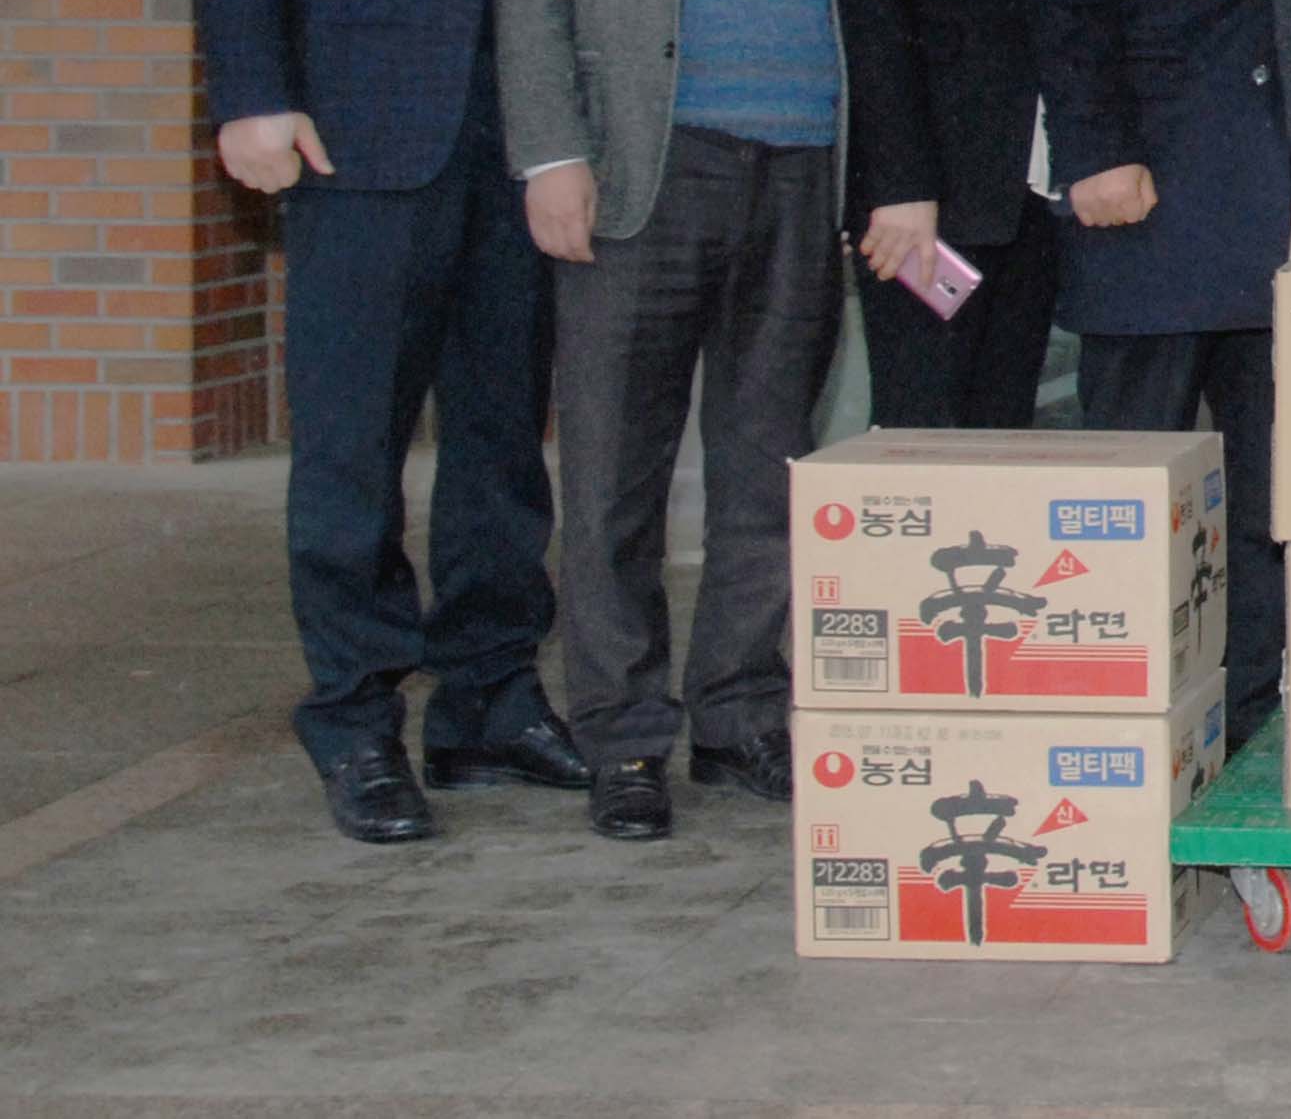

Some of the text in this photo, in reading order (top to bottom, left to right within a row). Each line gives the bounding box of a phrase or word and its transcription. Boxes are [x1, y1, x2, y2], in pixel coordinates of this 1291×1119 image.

[860, 508, 932, 537] 농심
[1057, 505, 1136, 535] 멀티팩
[1056, 557, 1075, 575] 신
[821, 614, 878, 635] 2283
[919, 530, 1048, 699] 辛
[1046, 609, 1129, 643] 라면
[860, 758, 932, 786] 농심
[1057, 753, 1136, 781] 멀티팩
[1056, 806, 1075, 824] 신
[816, 861, 886, 883] 가2283
[919, 780, 1048, 946] 辛
[1046, 858, 1129, 892] 라면
